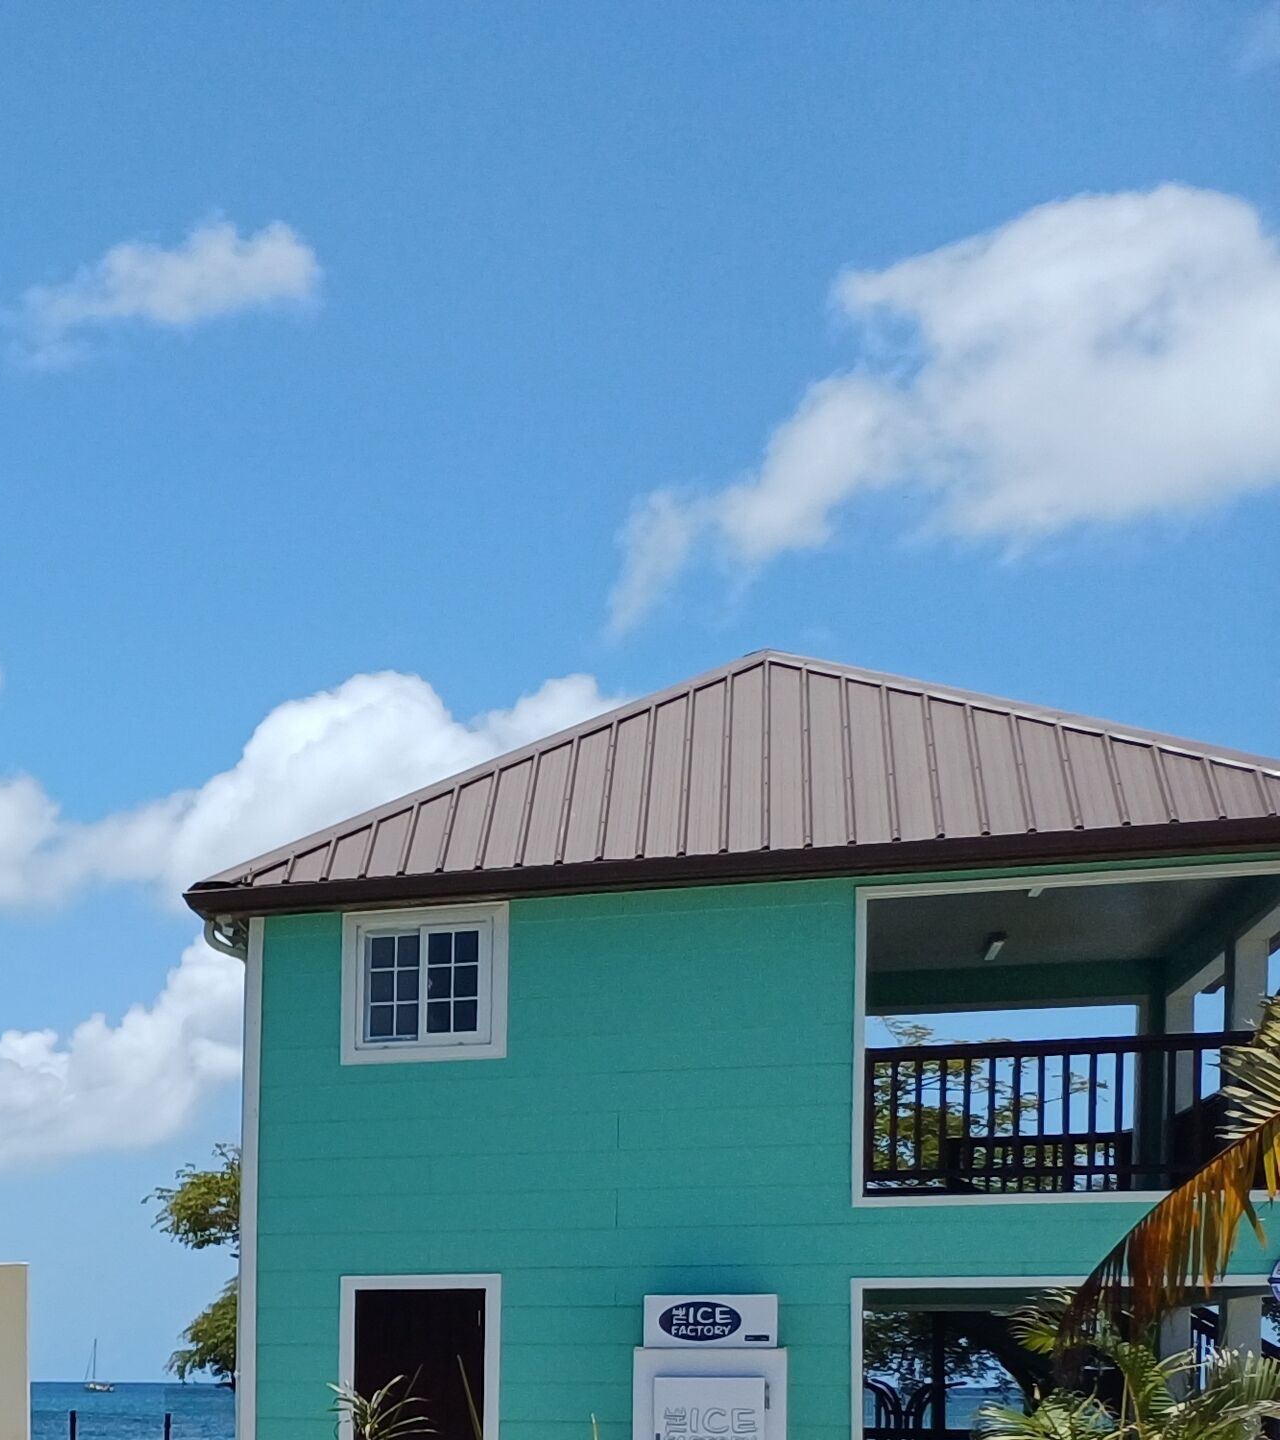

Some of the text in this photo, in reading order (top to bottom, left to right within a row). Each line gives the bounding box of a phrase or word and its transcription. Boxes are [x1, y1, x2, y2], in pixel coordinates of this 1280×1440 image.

[672, 1307, 732, 1325] THE ICE
[671, 1325, 731, 1336] FACTORY
[664, 1407, 758, 1434] THE ICE
